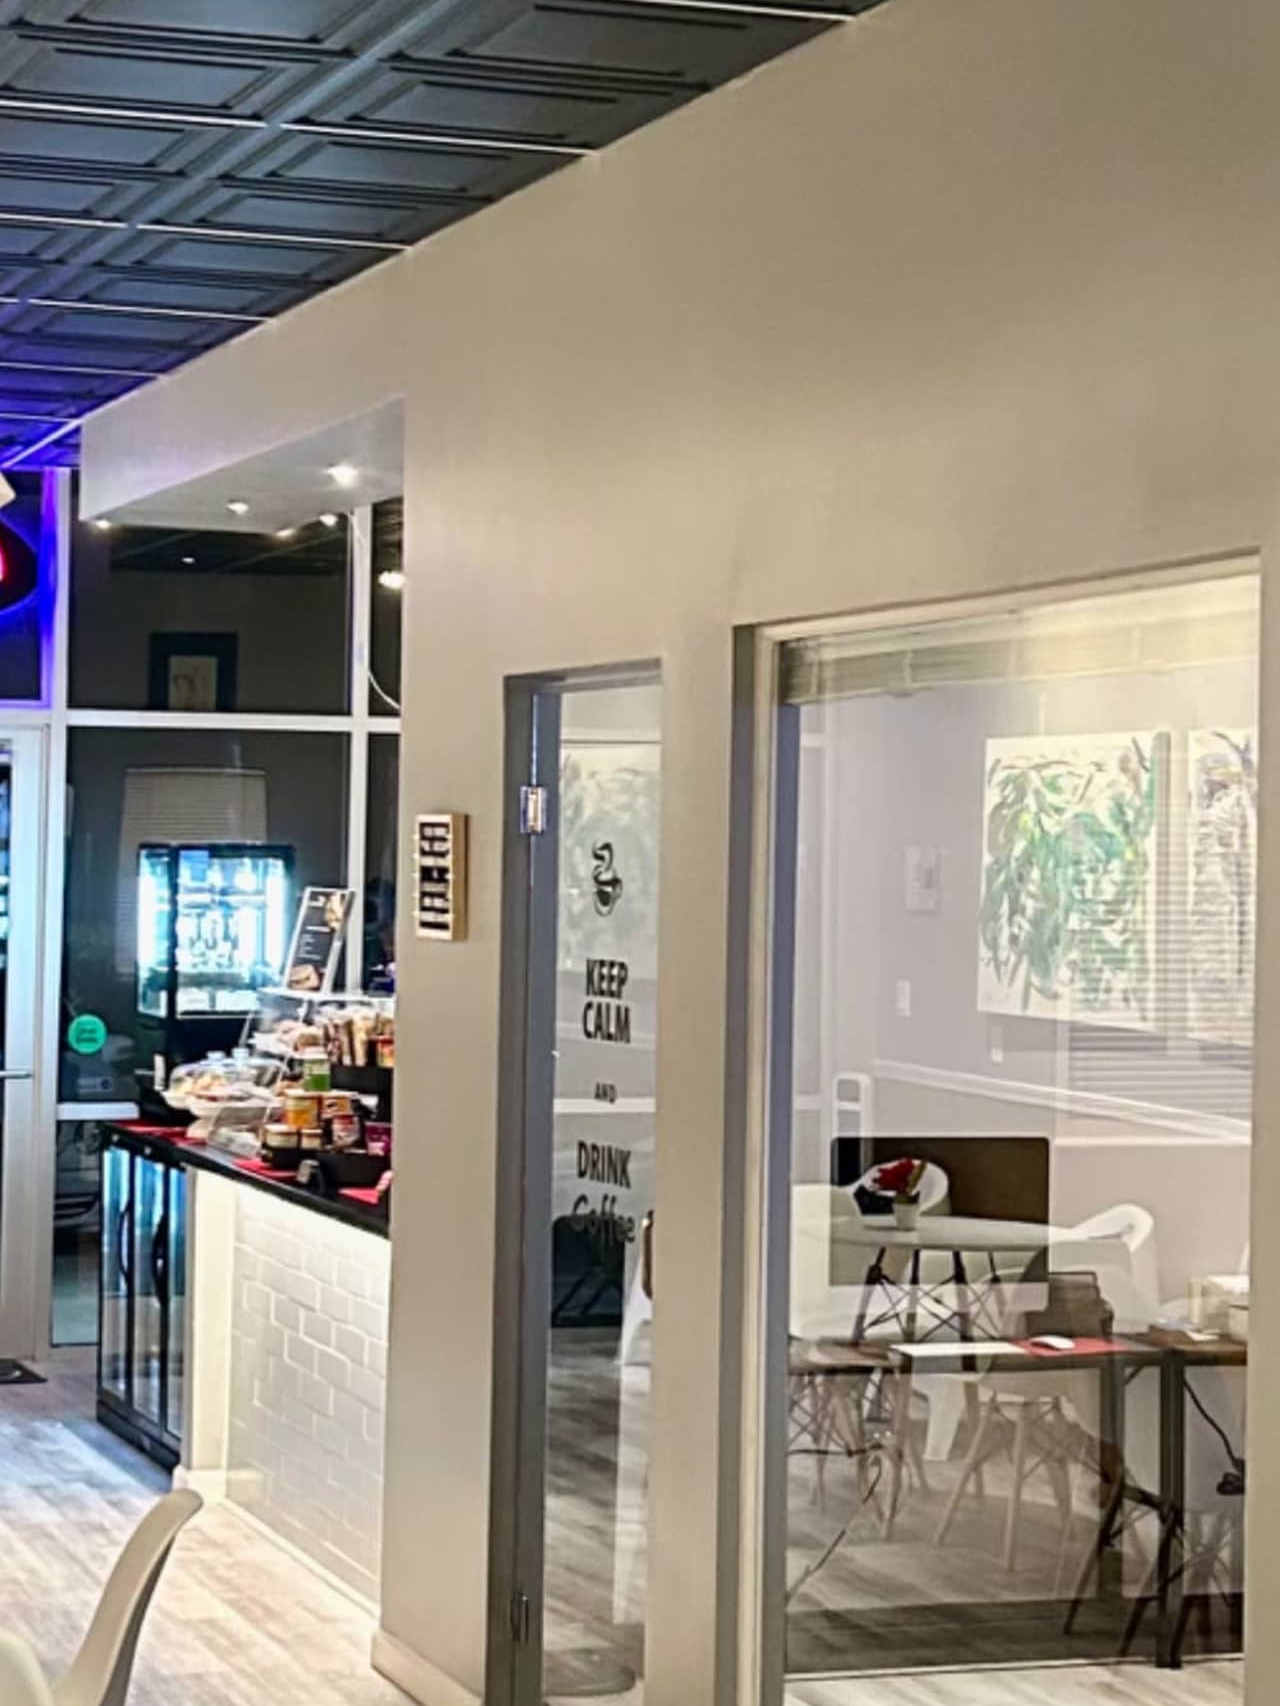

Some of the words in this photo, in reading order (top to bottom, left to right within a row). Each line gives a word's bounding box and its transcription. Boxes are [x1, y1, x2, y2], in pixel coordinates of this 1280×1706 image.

[586, 957, 629, 999] KEEP
[582, 1000, 631, 1044] CALM
[594, 1082, 618, 1104] AND
[577, 1140, 632, 1189] DRINK
[571, 1193, 636, 1244] Coffee
